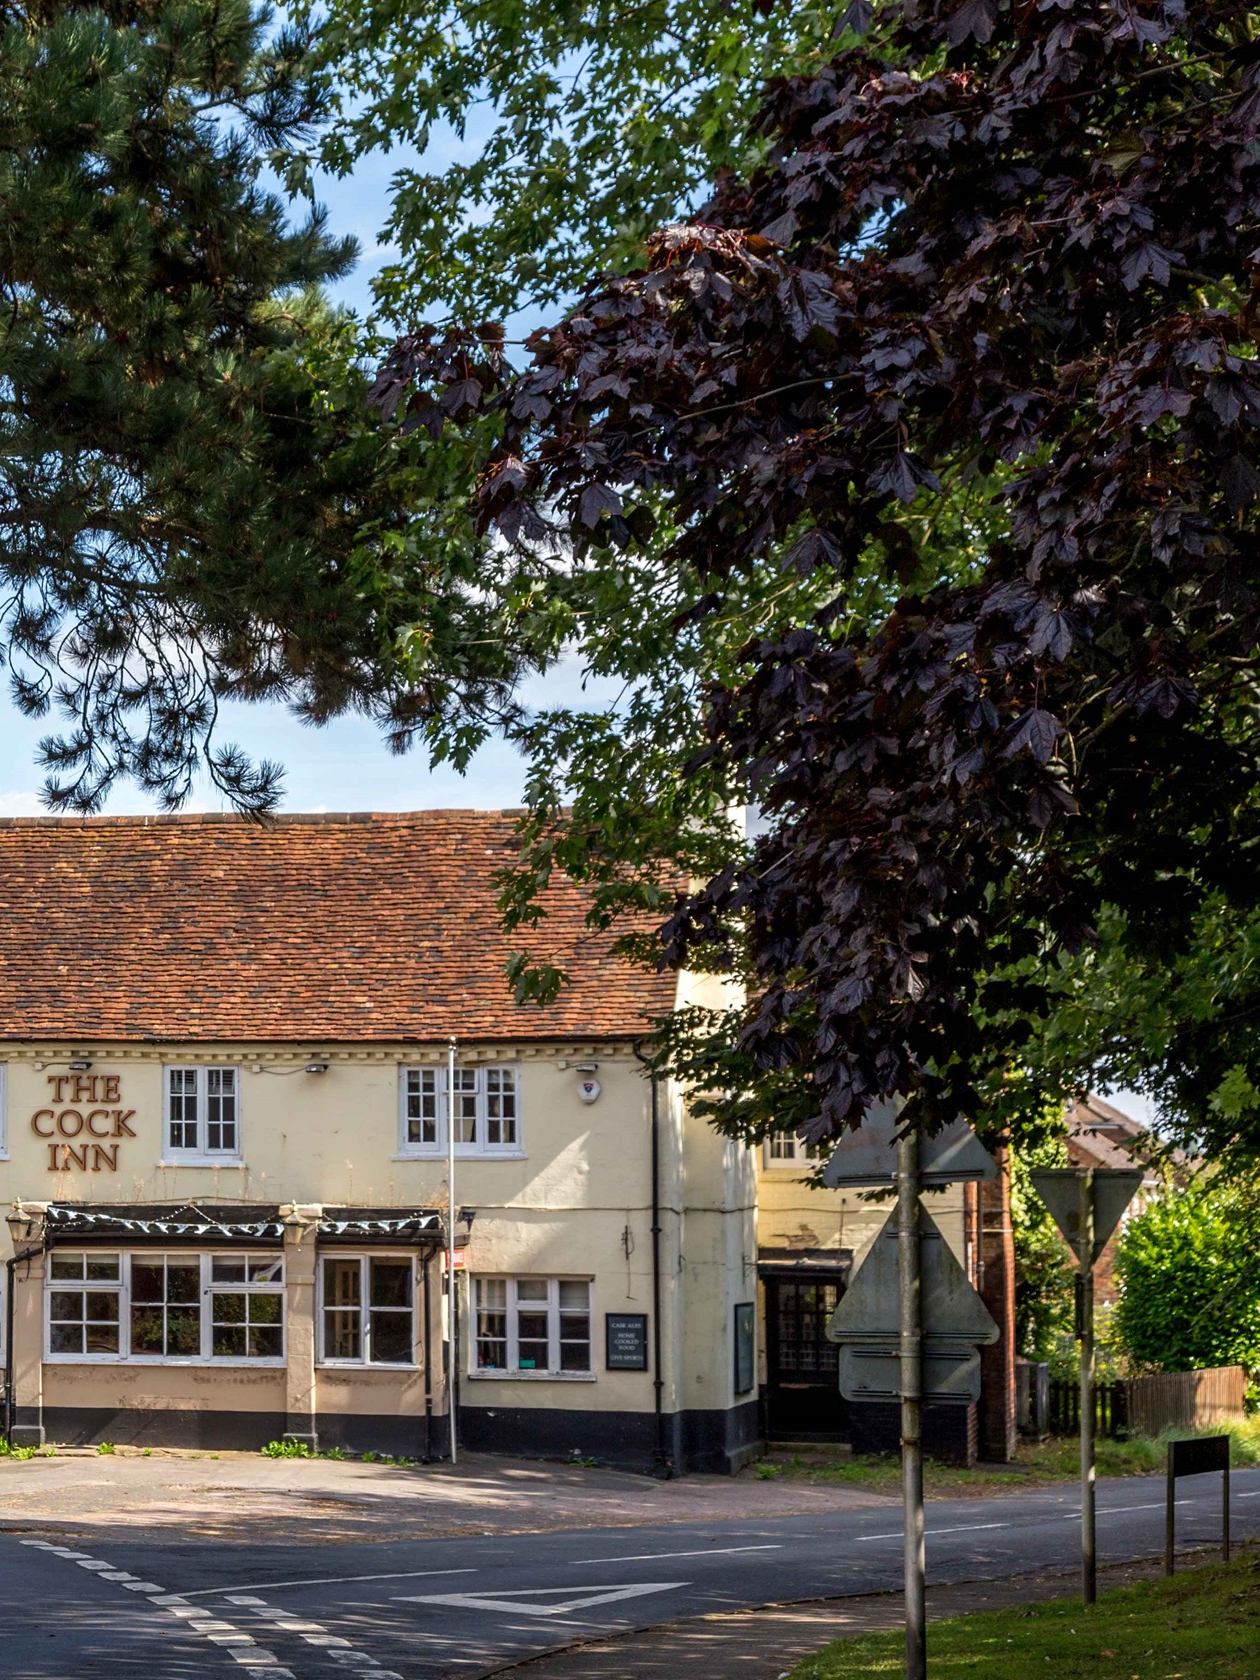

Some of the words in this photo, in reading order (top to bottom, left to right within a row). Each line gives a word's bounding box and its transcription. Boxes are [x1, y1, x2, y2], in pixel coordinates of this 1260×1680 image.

[47, 1075, 121, 1103] THE
[30, 1109, 137, 1138] COCK
[47, 1143, 120, 1172] INN
